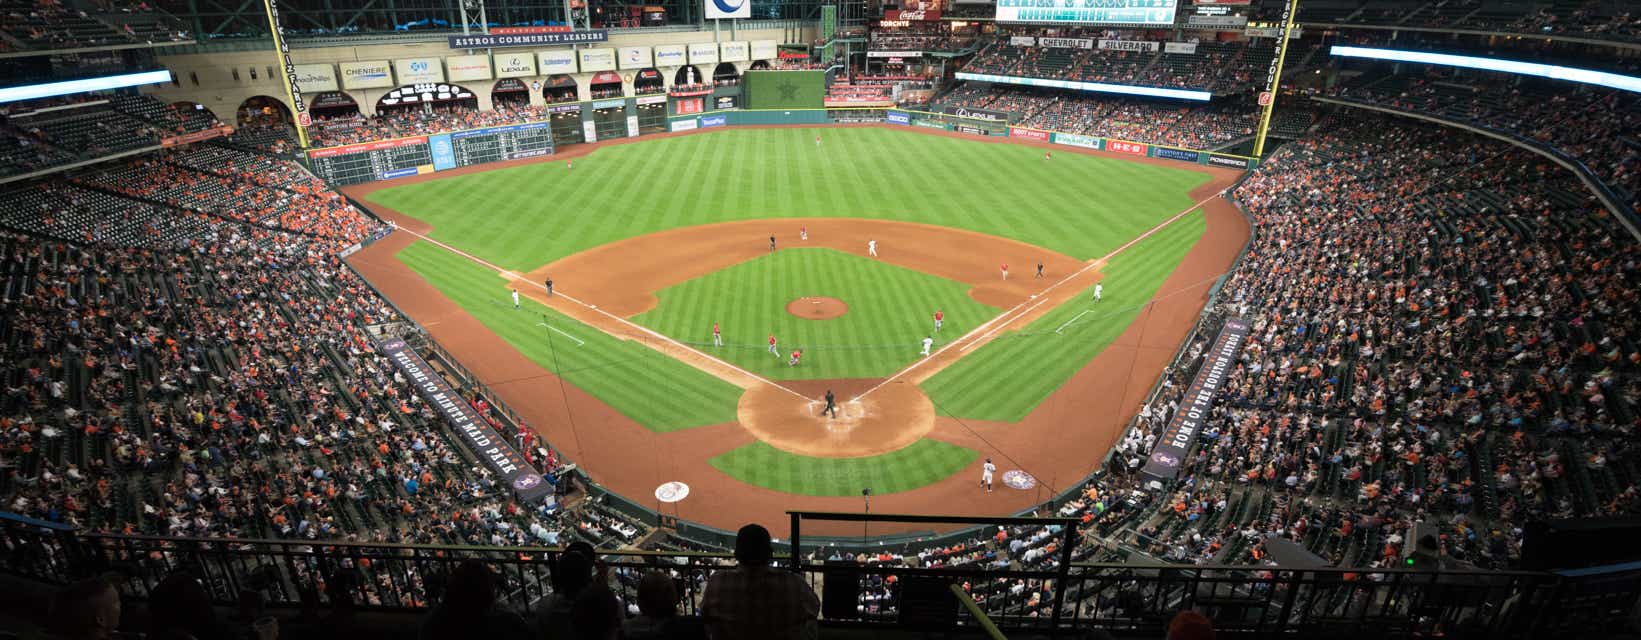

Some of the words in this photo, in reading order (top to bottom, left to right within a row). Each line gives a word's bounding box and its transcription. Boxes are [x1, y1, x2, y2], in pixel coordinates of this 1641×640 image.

[455, 36, 495, 46] ASTROS
[499, 34, 560, 44] COMMUNITY
[564, 32, 603, 42] LEADERS
[1043, 38, 1088, 48] CHEVROLET
[1105, 41, 1153, 51] SILVERADO
[285, 55, 294, 73] IZ
[346, 66, 386, 76] CHENIERE
[1266, 57, 1278, 91] FOUL
[1209, 156, 1247, 167] POWERADE
[1222, 333, 1241, 357] ASTROS
[1204, 357, 1229, 390] HOUSTON
[1195, 390, 1212, 406] THE
[394, 351, 428, 383] WELCOME
[423, 377, 438, 393] TO
[432, 392, 469, 423] MINUTE
[462, 423, 491, 447] MAID
[486, 447, 517, 475] PARK
[1188, 406, 1204, 420] OF
[1171, 420, 1196, 449] HOME
